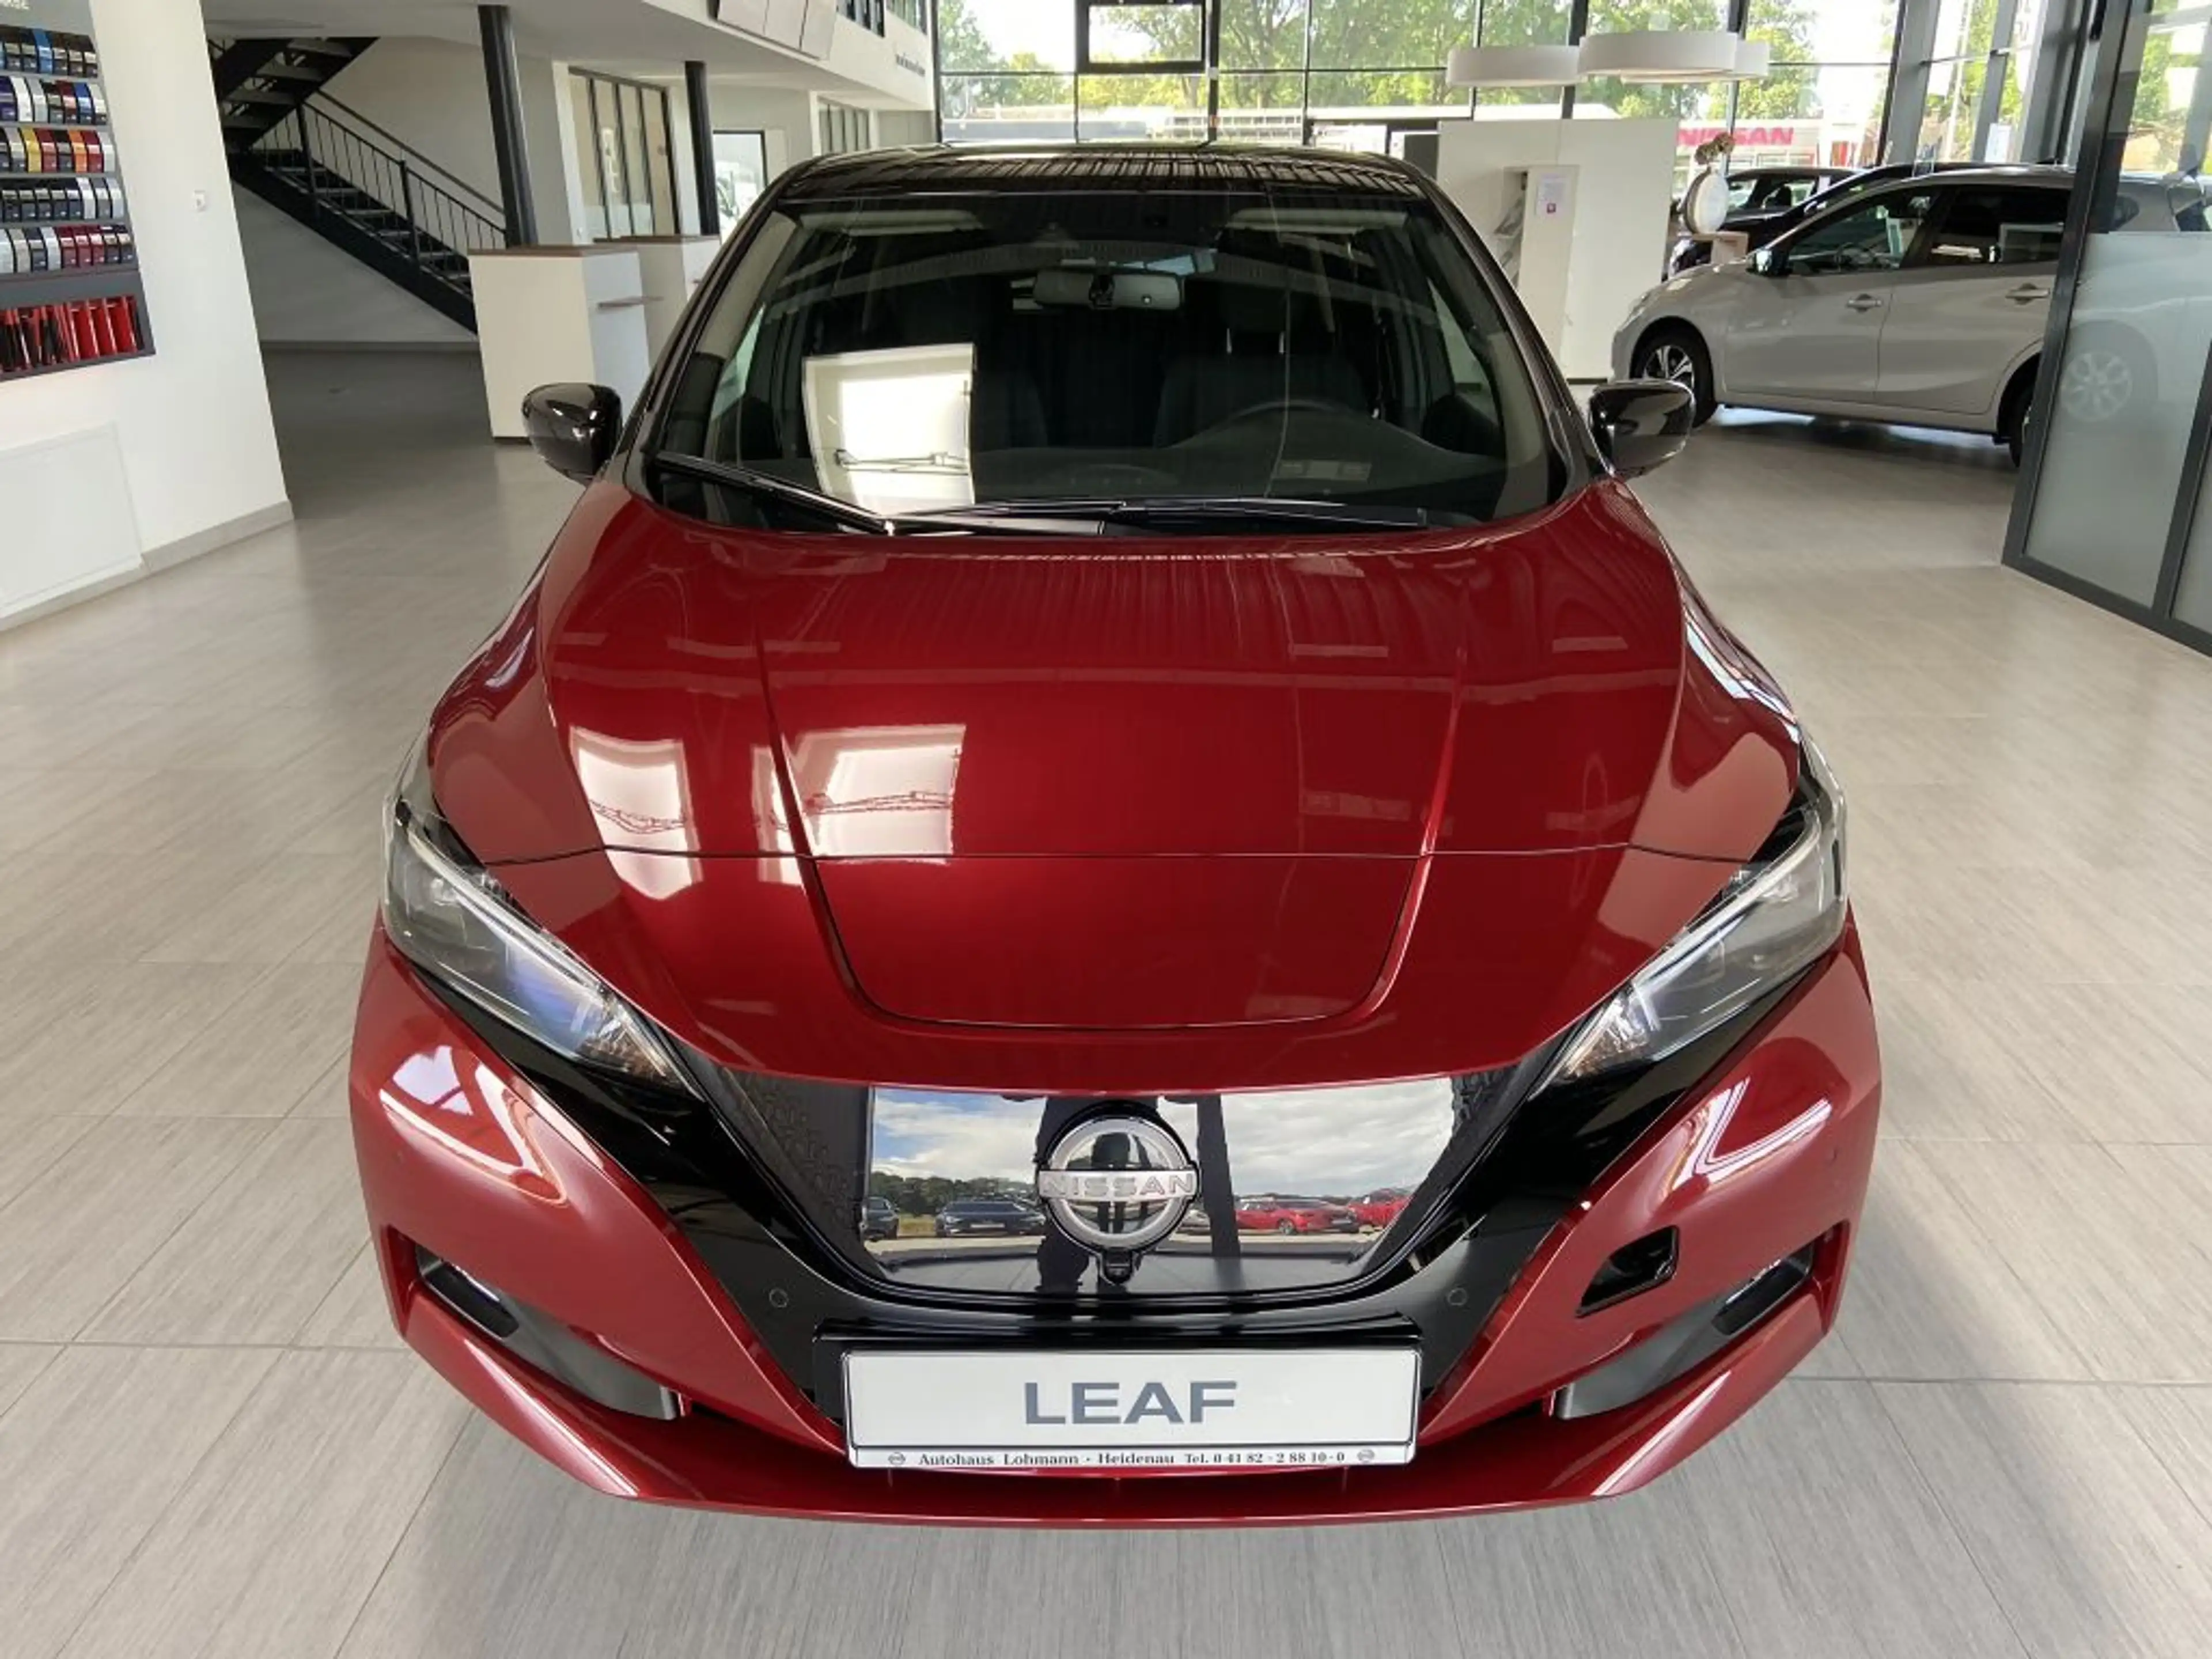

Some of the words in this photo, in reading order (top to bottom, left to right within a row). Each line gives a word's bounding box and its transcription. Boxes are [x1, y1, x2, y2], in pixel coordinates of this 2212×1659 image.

[1042, 1173, 1194, 1196] NISSAN
[1025, 1381, 1237, 1425] LEAF
[919, 1453, 994, 1465] Autohaus
[1003, 1453, 1080, 1465] Lohmann
[1099, 1452, 1175, 1464] Heidenau
[1184, 1453, 1209, 1463] Tel.
